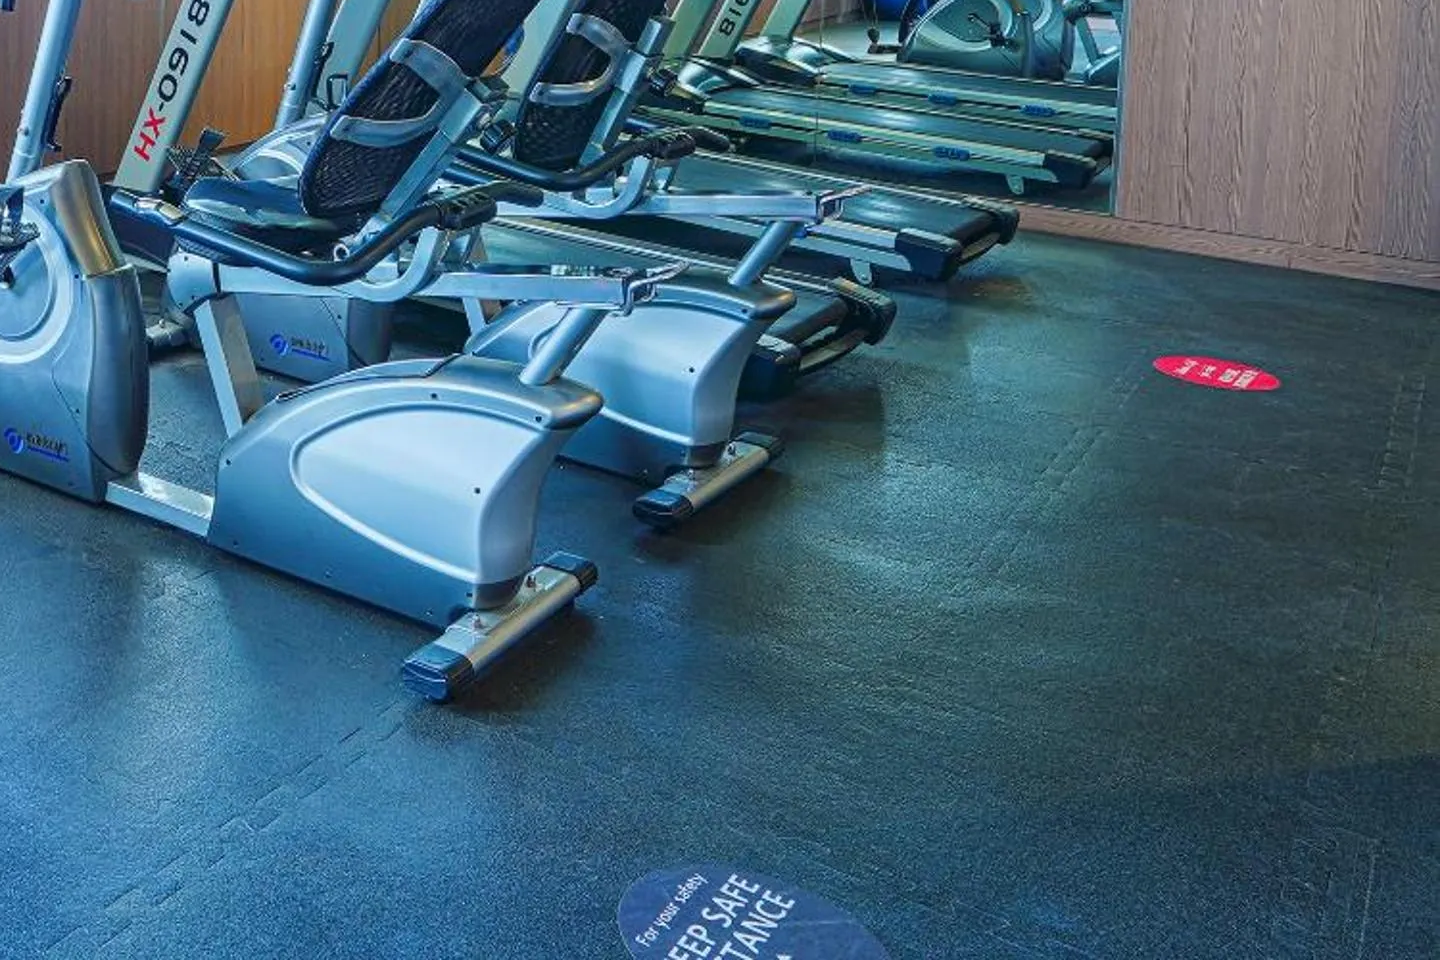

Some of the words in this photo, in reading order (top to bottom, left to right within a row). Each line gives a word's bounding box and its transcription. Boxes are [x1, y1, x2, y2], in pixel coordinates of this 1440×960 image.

[635, 926, 659, 948] For
[653, 901, 681, 930] your
[674, 872, 709, 904] safety
[664, 924, 716, 960] EEP
[701, 873, 760, 928] SAFE
[714, 890, 795, 960] TANCE
